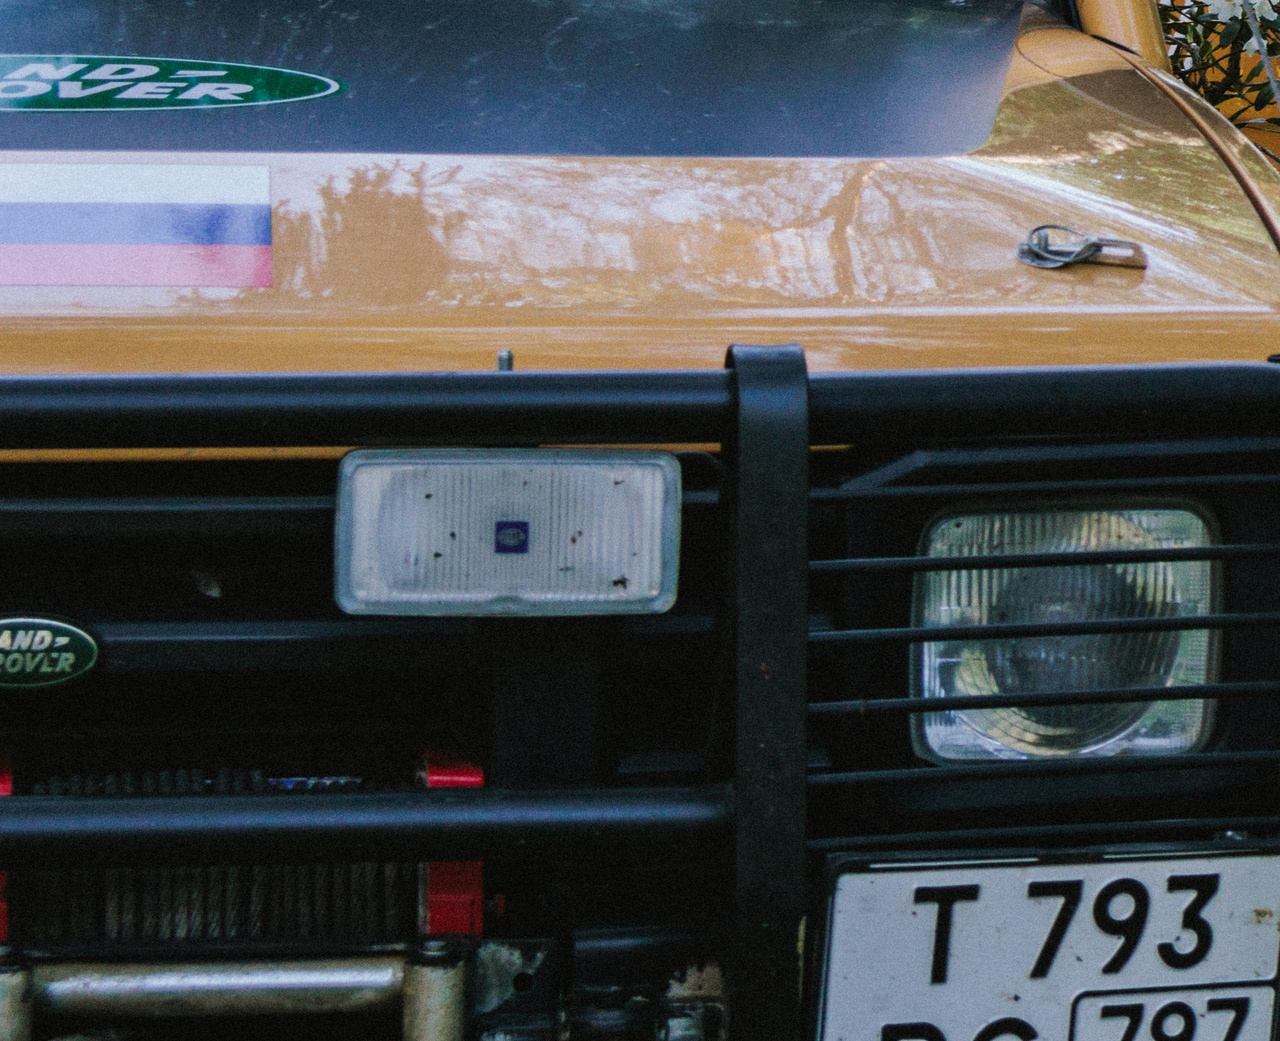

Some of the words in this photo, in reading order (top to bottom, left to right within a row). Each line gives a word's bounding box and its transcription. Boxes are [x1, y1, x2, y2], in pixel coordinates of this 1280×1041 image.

[0, 652, 75, 674] OVER
[914, 884, 981, 985] T
[1027, 873, 1221, 980] 793
